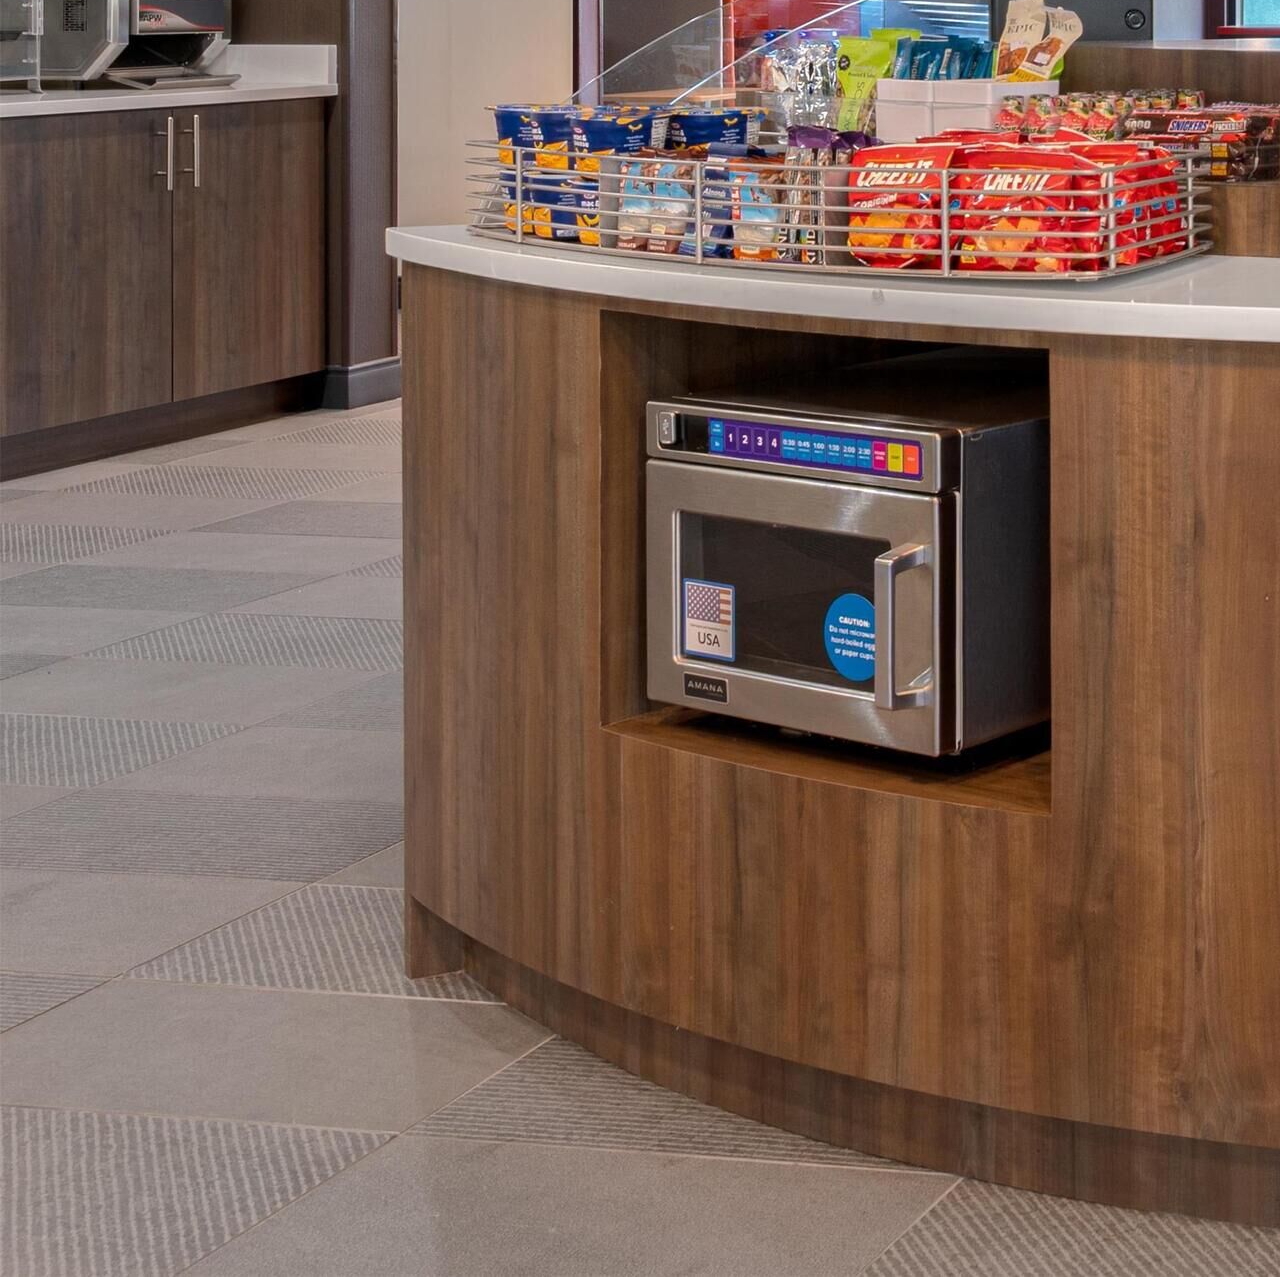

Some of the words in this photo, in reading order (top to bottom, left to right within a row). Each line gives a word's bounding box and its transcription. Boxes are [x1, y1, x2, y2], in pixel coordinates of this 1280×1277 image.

[1008, 24, 1038, 35] EPIC
[1168, 120, 1210, 132] SNICKERS
[813, 442, 825, 450] 1:00
[839, 616, 870, 628] CAUTION:
[697, 632, 720, 648] USA
[688, 681, 724, 694] AMANA
